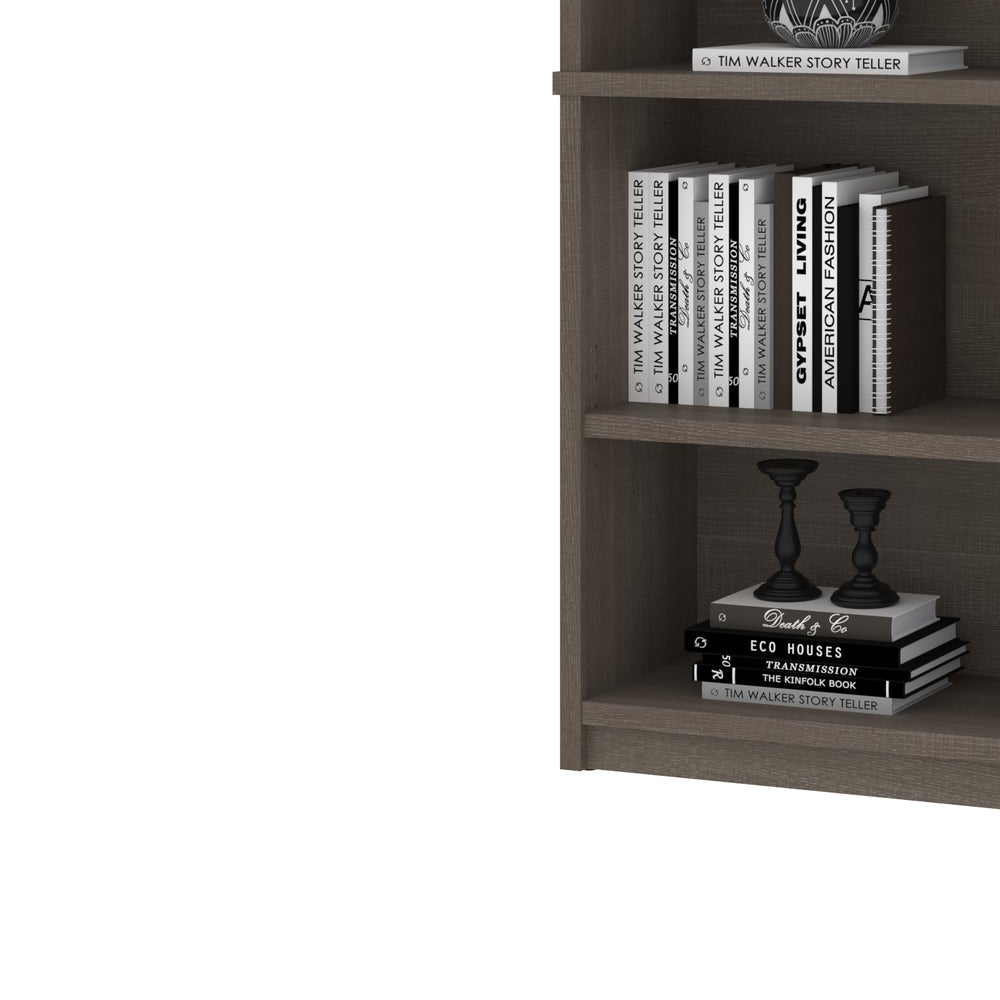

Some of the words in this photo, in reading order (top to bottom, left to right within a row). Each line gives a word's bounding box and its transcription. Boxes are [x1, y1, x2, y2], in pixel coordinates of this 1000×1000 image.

[718, 55, 741, 67] TIM
[745, 56, 802, 68] WALKER
[806, 57, 850, 69] STORY
[855, 57, 901, 70] TELLER
[633, 179, 644, 227] TELLER
[653, 180, 664, 228] TELLER
[714, 182, 724, 230] TELLER
[633, 232, 644, 279] STORY
[653, 233, 664, 280] STORY
[678, 241, 690, 261] Co
[697, 217, 706, 257] TELLER
[739, 243, 751, 263] Co
[758, 219, 767, 260] TELLER
[796, 198, 807, 275] LIVING
[824, 196, 835, 280] FASHION
[714, 235, 724, 283] STORY
[669, 237, 678, 335] TRANSMISSION
[697, 261, 706, 300] STORY
[730, 240, 738, 338] TRANSMISSION
[758, 264, 767, 303] STORY
[633, 284, 644, 344] WALKER
[653, 285, 664, 345] WALKER
[678, 279, 690, 328] Death
[714, 287, 724, 348] WALKER
[739, 281, 751, 331] Death
[697, 305, 706, 356] WALKER
[758, 308, 767, 359] WALKER
[796, 292, 807, 385] GYPSET
[824, 287, 835, 389] AMERICAN
[633, 350, 644, 374] TIM
[653, 351, 664, 375] TIM
[668, 373, 678, 383] 50
[697, 361, 706, 381] TIM
[714, 353, 724, 378] TIM
[729, 376, 739, 386] 50
[758, 364, 767, 384] TIM
[762, 608, 812, 631] Death
[806, 622, 820, 636] &
[828, 613, 850, 634] Co
[721, 654, 731, 668] 50
[750, 639, 777, 653] ECO
[787, 643, 843, 659] HOUSES
[766, 660, 859, 677] TRANSMISSION
[724, 687, 744, 699] TIM
[748, 690, 795, 704] WALKER
[799, 694, 837, 708] STORY
[839, 698, 878, 712] TELLER
[762, 674, 782, 683] THE
[784, 675, 826, 688] KINFOLK
[829, 678, 857, 690] BOOK
